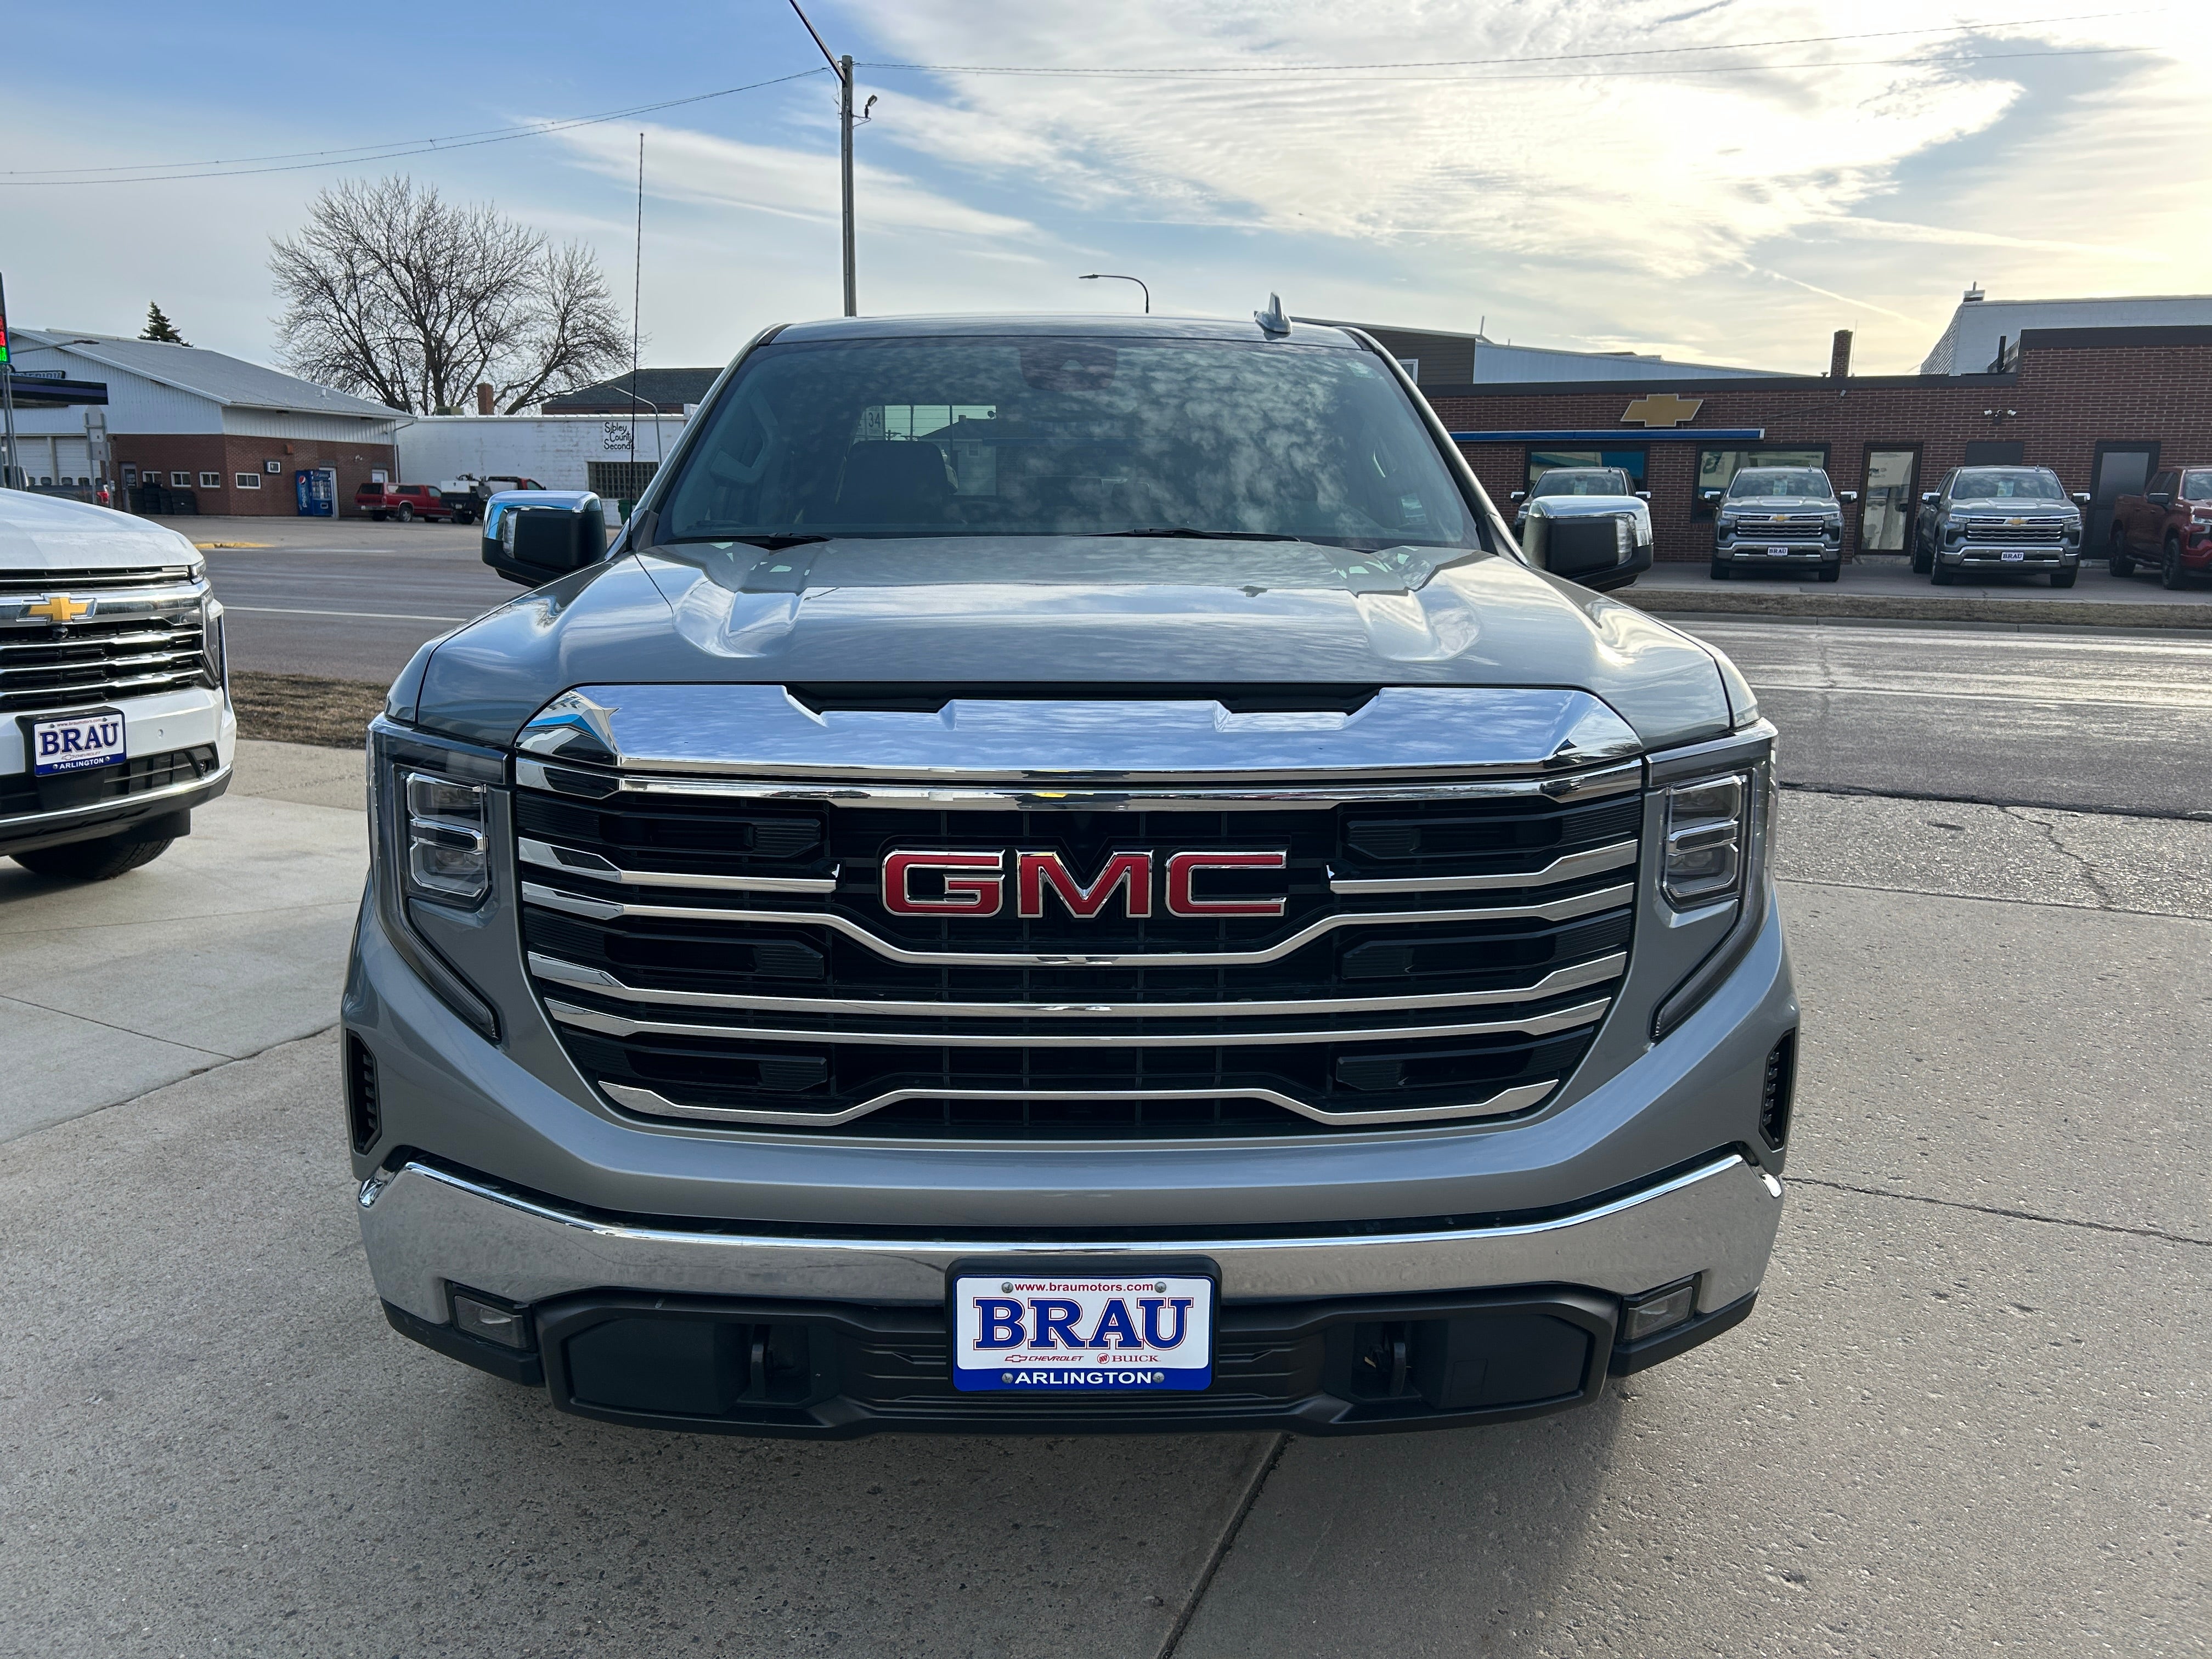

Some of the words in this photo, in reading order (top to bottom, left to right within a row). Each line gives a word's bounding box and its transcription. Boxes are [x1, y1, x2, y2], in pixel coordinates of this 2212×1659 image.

[868, 411, 881, 428] 34
[605, 421, 627, 435] Sibley
[603, 438, 635, 450] Second
[610, 431, 632, 444] County
[38, 721, 119, 758] BRAU
[59, 757, 104, 770] ARLINGTON
[882, 849, 1288, 918] GMC
[1014, 1282, 1154, 1292] www.braumotors.com
[973, 1296, 1194, 1351] BRAU
[1111, 1355, 1160, 1363] BUICK
[1014, 1372, 1152, 1384] ARLINGTON
